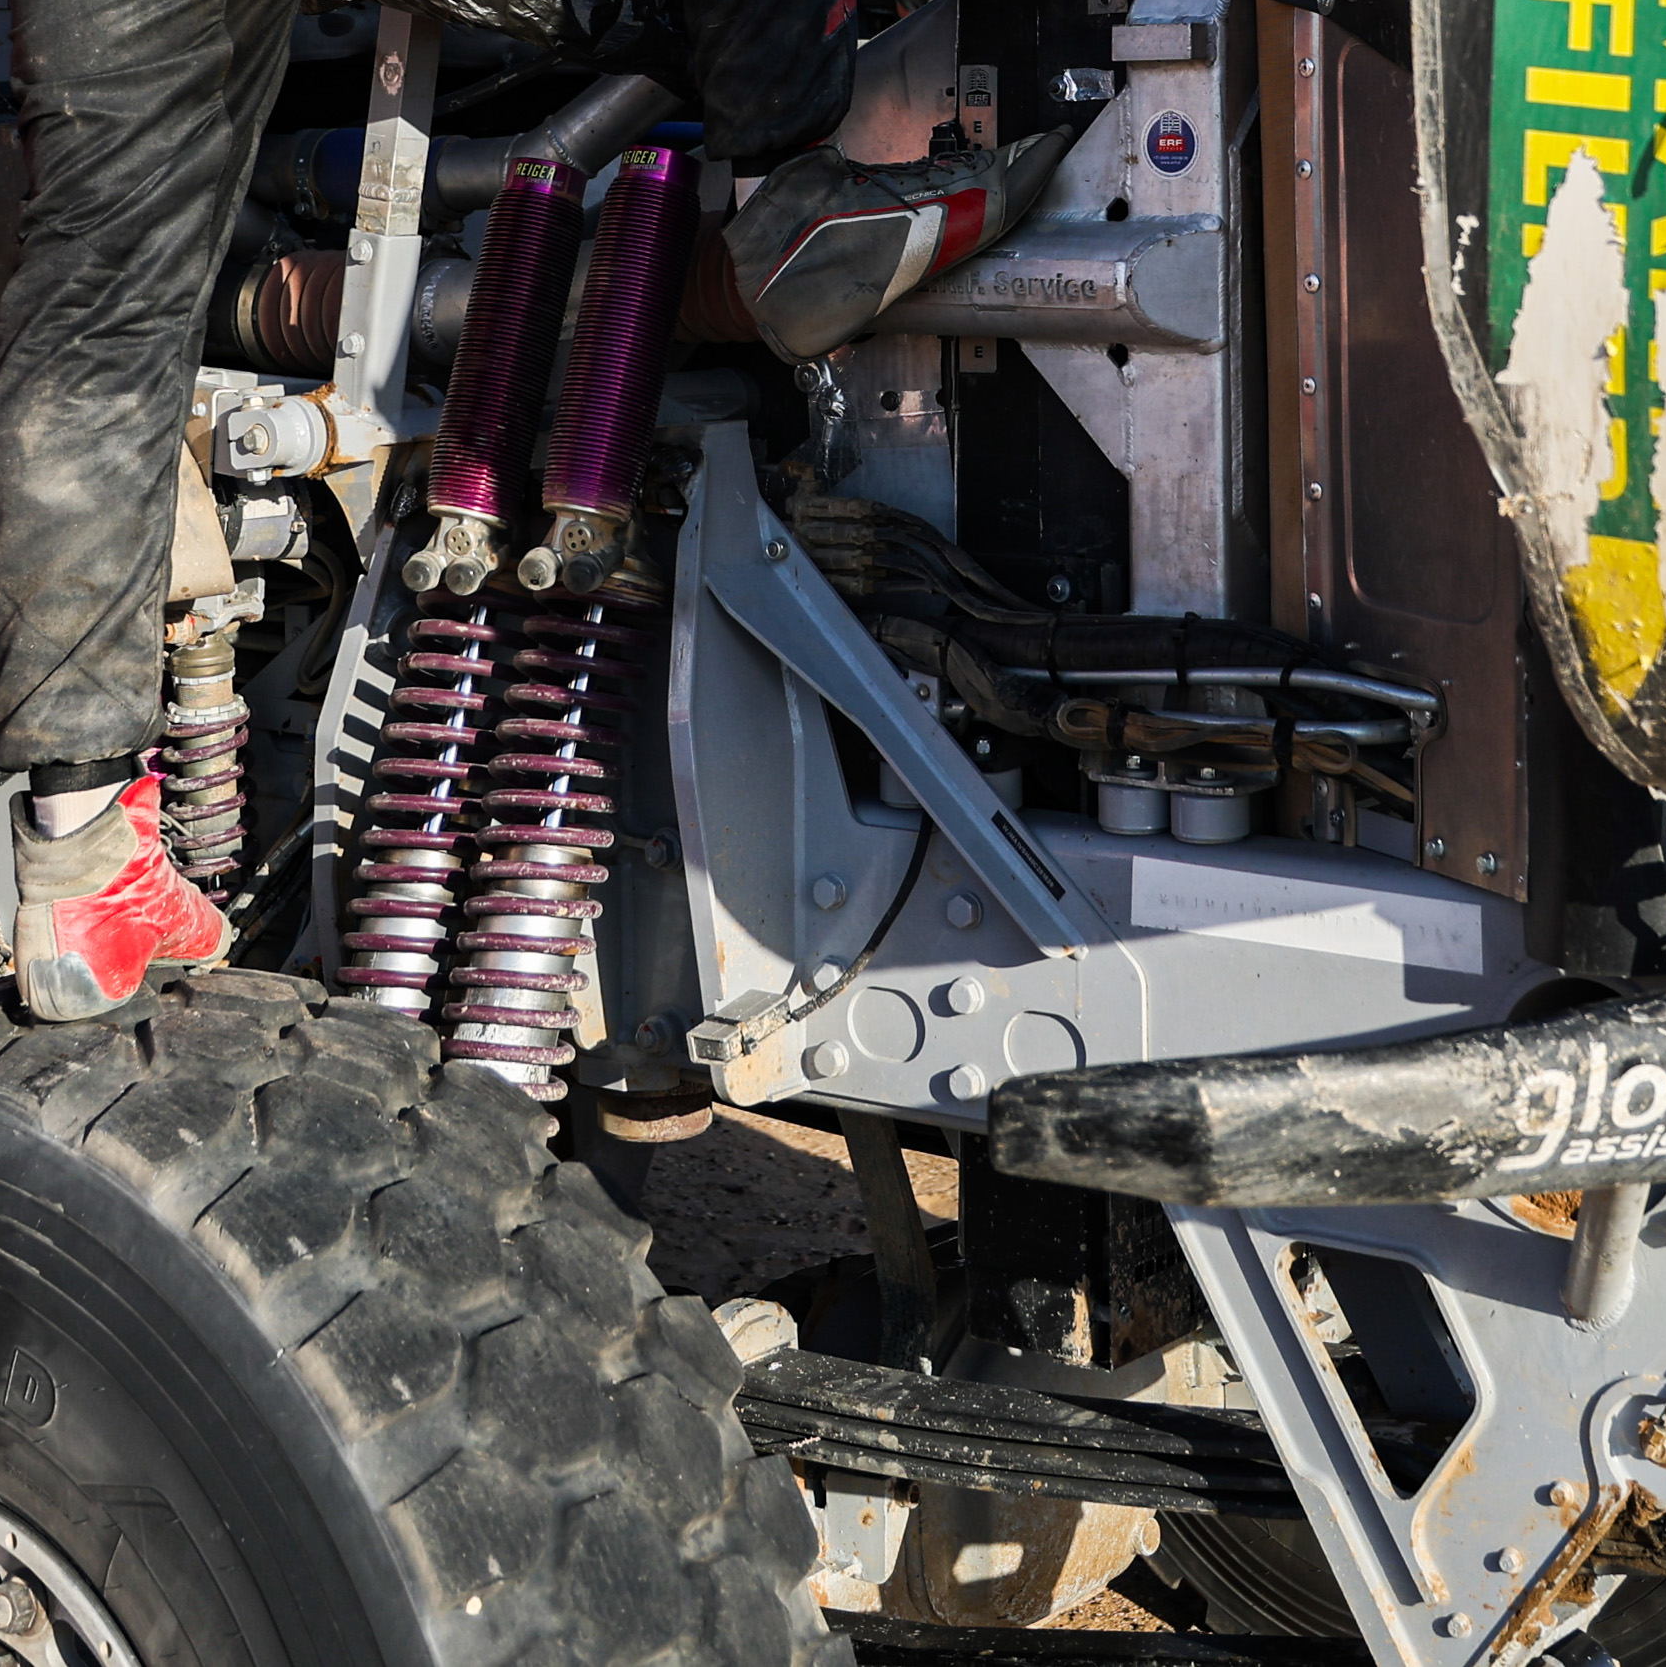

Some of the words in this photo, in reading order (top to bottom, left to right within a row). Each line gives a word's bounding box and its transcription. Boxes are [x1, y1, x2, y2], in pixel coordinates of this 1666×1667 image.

[1159, 138, 1183, 147] ERF
[514, 162, 558, 180] REIGER
[901, 188, 946, 202] ECNICA
[992, 269, 1099, 299] Service
